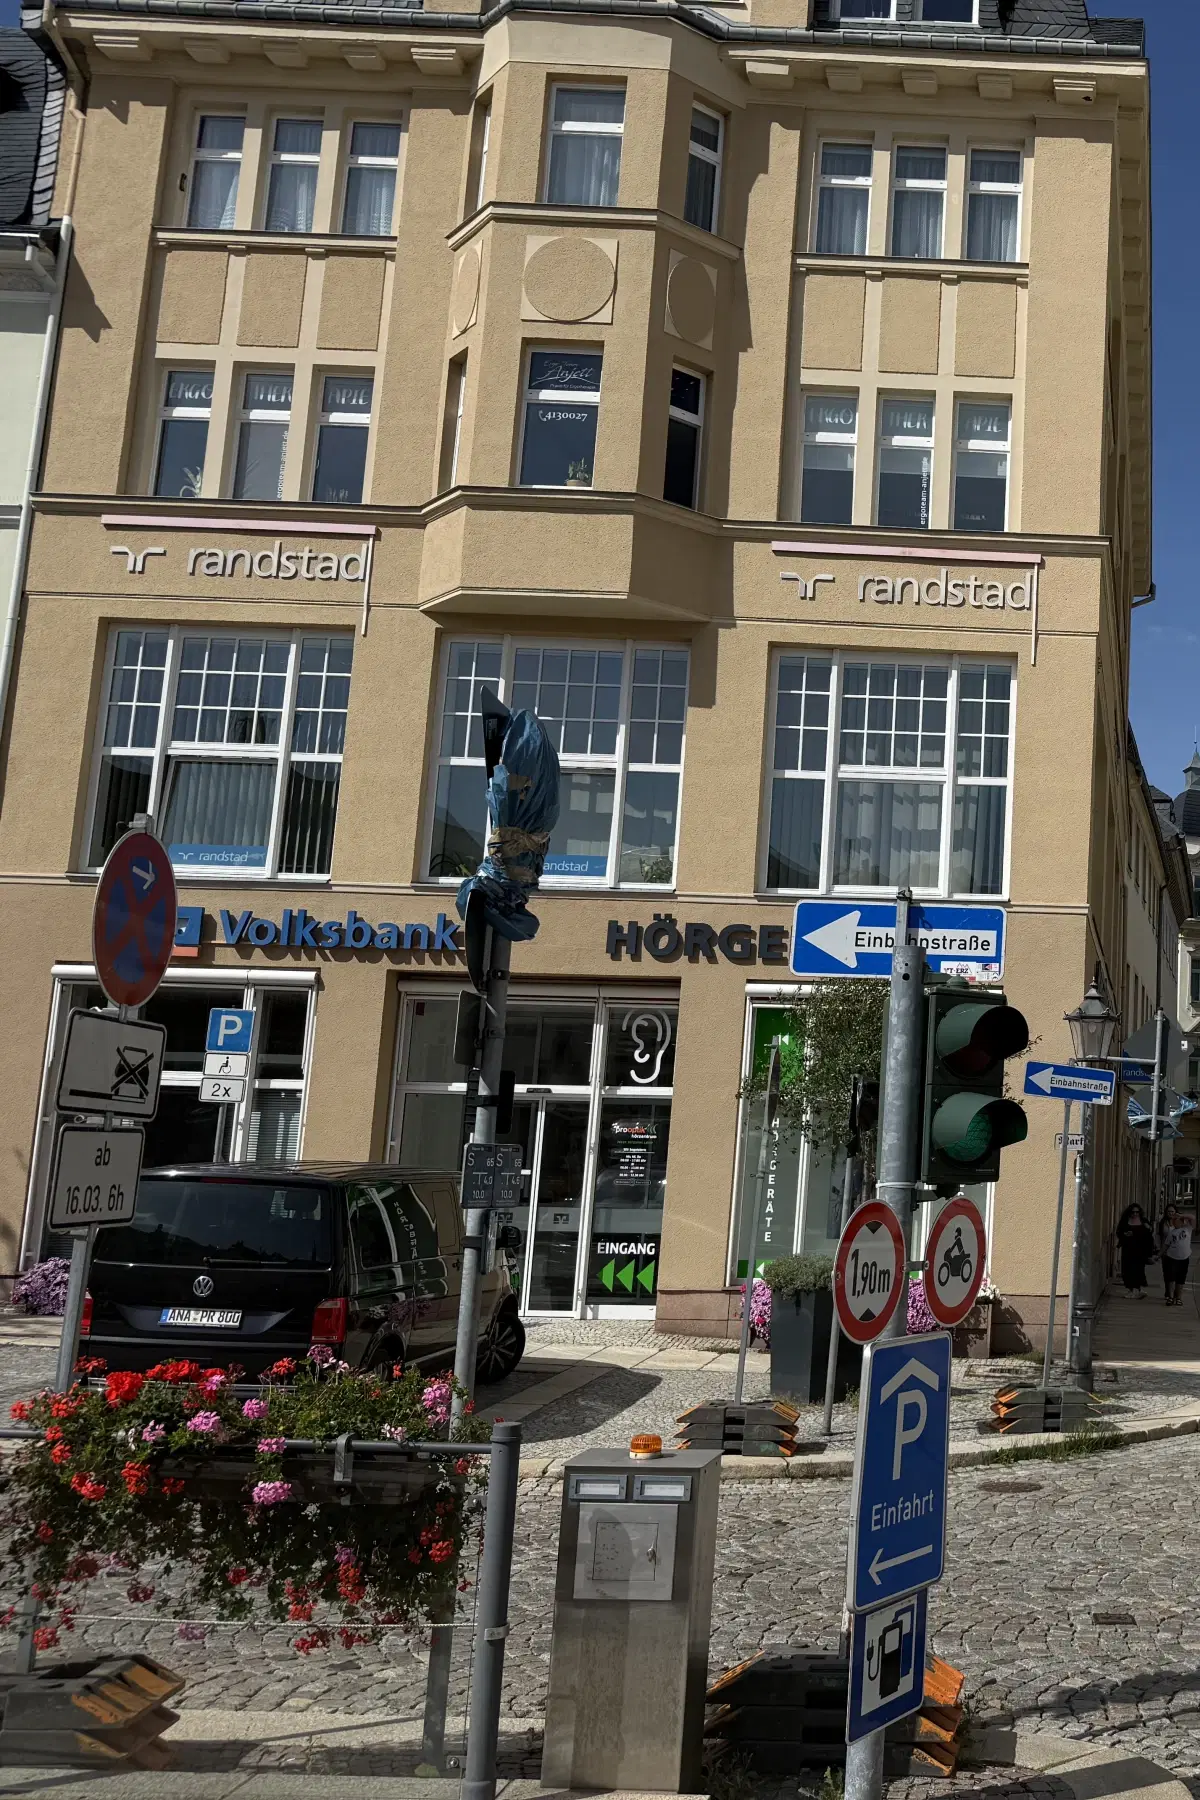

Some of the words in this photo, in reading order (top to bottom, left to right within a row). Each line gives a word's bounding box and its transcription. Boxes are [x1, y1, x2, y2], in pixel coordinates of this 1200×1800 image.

[545, 411, 588, 422] 4130027
[187, 540, 368, 581] randstad
[858, 567, 1032, 610] randstad
[199, 851, 249, 862] randstad
[543, 860, 589, 872] andstad
[220, 908, 460, 950] Volksbank
[606, 913, 791, 961] HÖRGE
[855, 931, 991, 952] Einbhnstraße
[217, 1014, 243, 1047] P
[1050, 1076, 1108, 1092] Einbahnstraße
[94, 1140, 111, 1167] ab
[65, 1184, 102, 1215] 16.03.
[108, 1183, 124, 1212] 6h
[597, 1242, 656, 1255] EINGANG
[168, 1308, 191, 1322] ANA
[200, 1309, 216, 1323] PR
[218, 1310, 240, 1324] 800
[892, 1389, 928, 1481] P
[871, 1489, 935, 1532] Einfahrt
